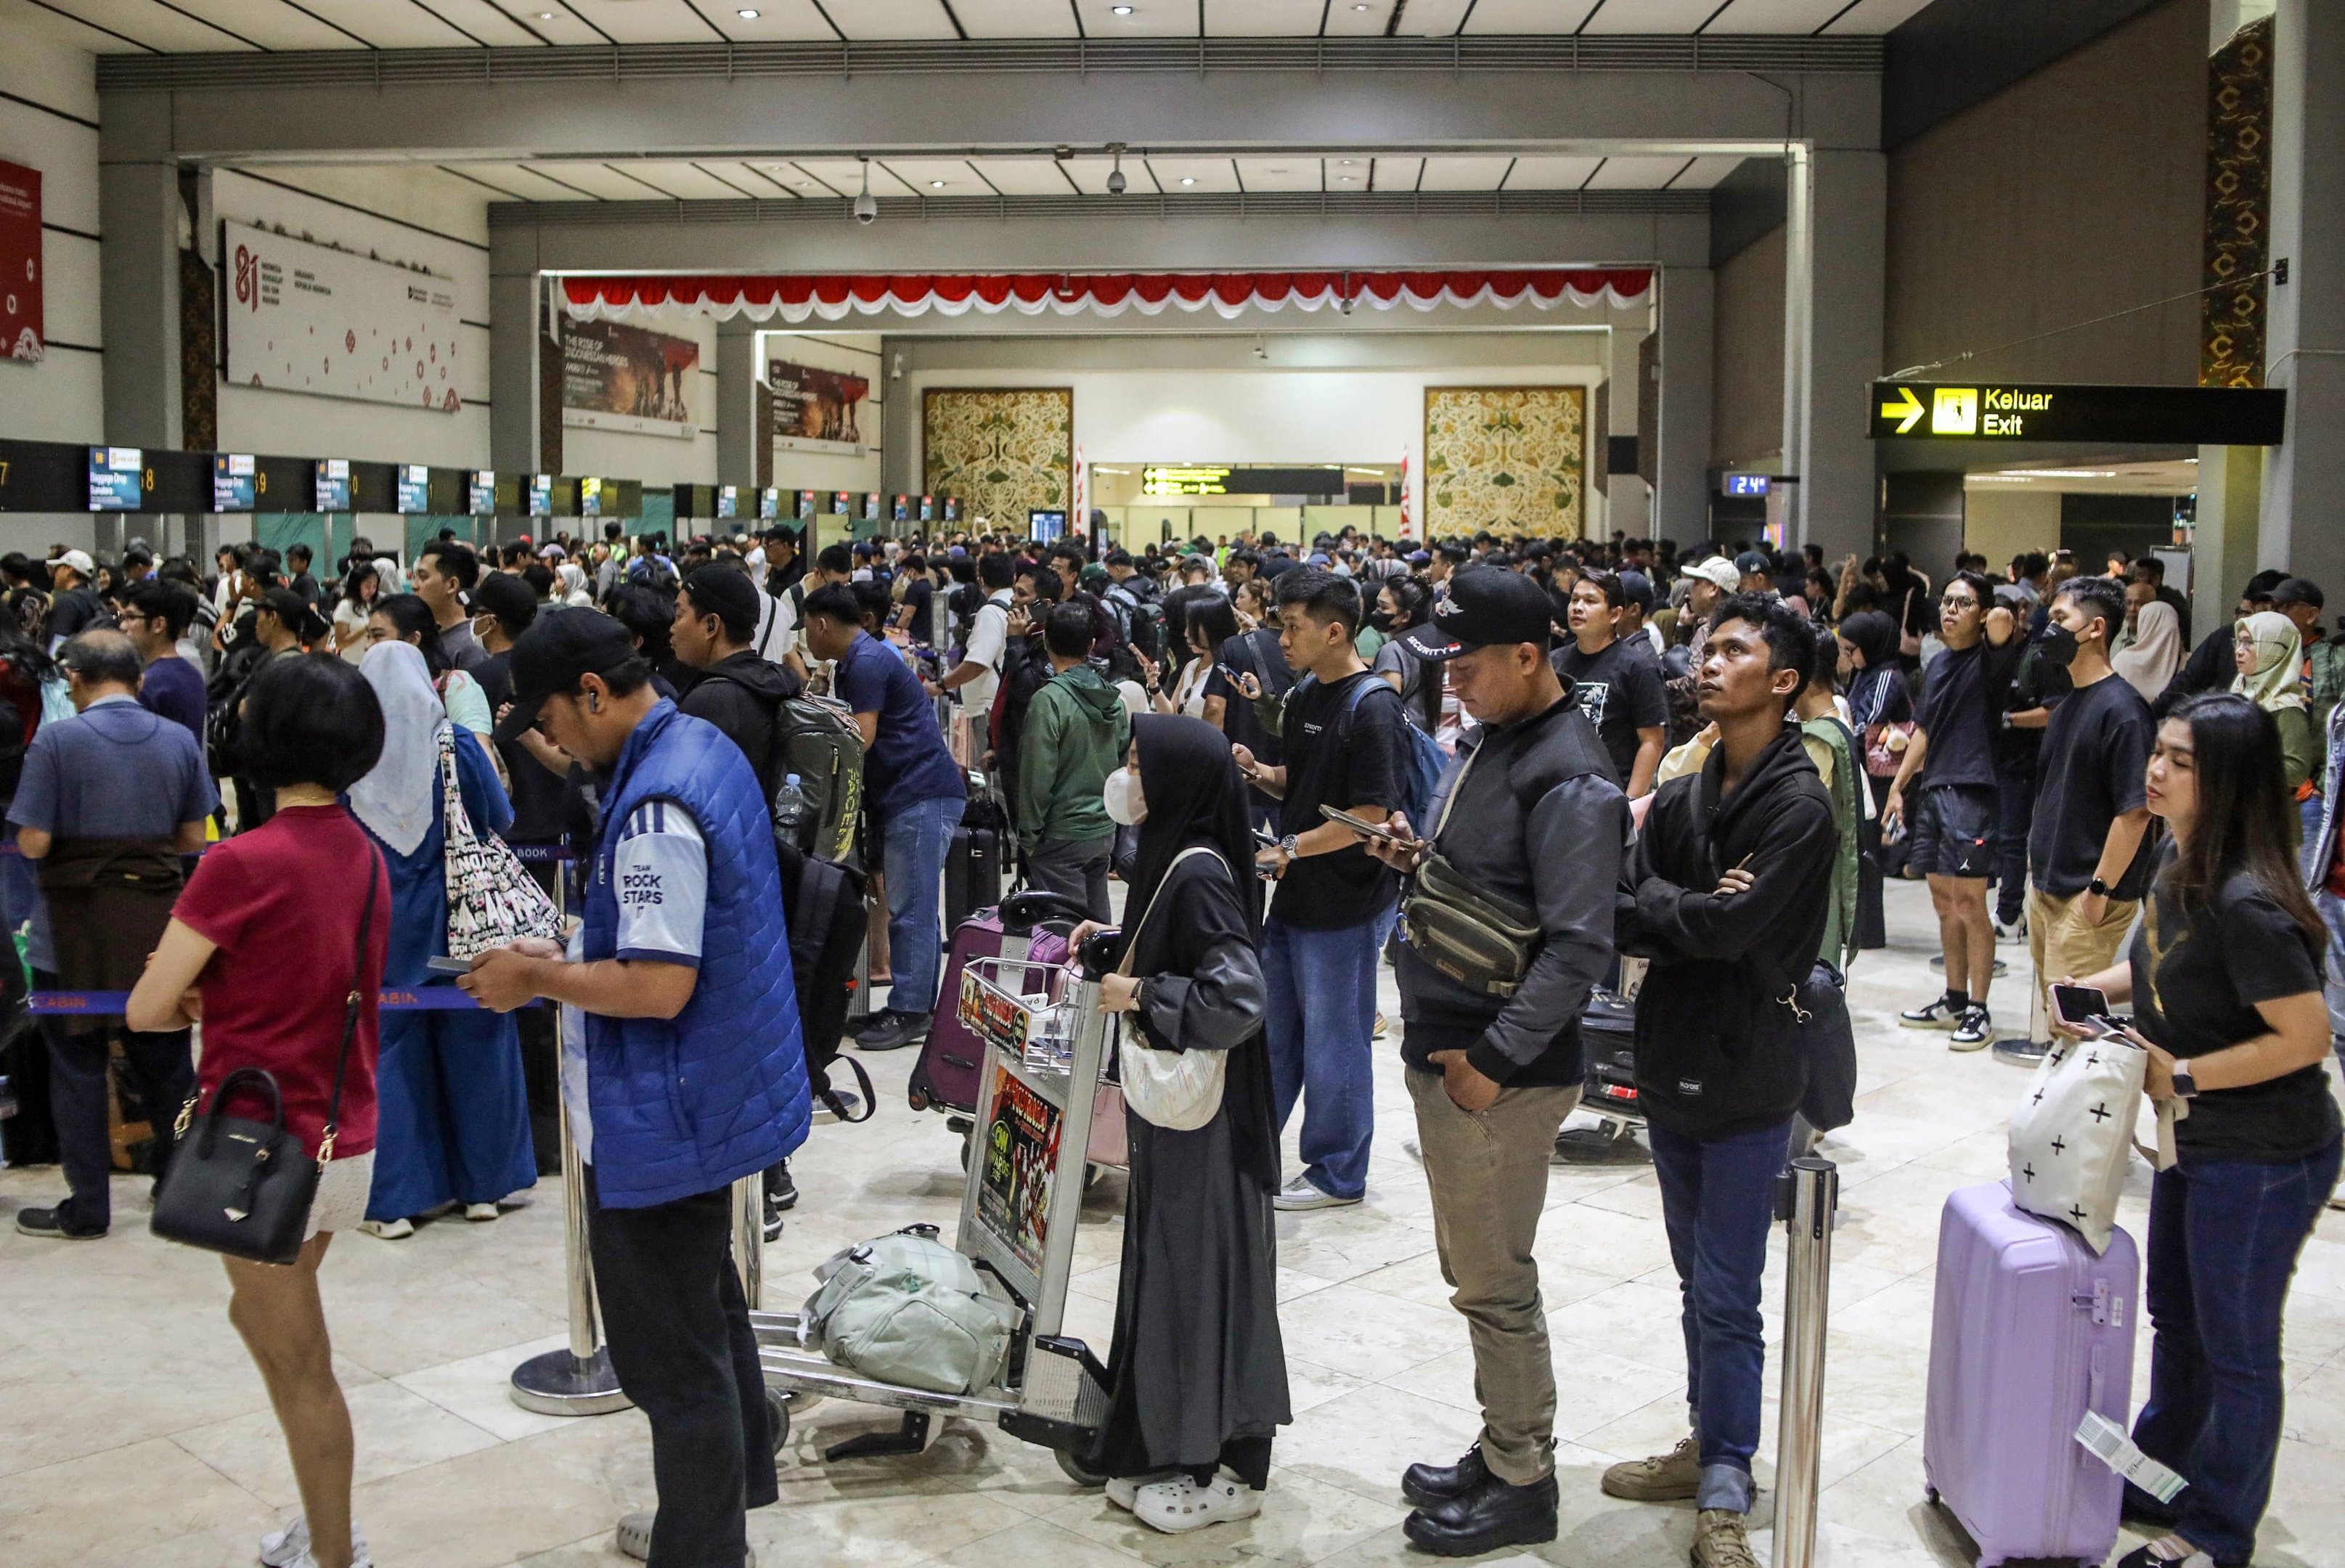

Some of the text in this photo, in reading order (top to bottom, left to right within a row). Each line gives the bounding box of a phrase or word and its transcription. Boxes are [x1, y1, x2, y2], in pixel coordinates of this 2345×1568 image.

[1985, 388, 2053, 410] Keluar
[1983, 414, 2023, 435] Exit
[255, 472, 267, 494] 9
[1406, 635, 1448, 656] SECURITY
[517, 848, 547, 857] BOOK
[623, 874, 662, 889] ROCK
[623, 891, 663, 905] STARS
[378, 992, 417, 1005] ABIN
